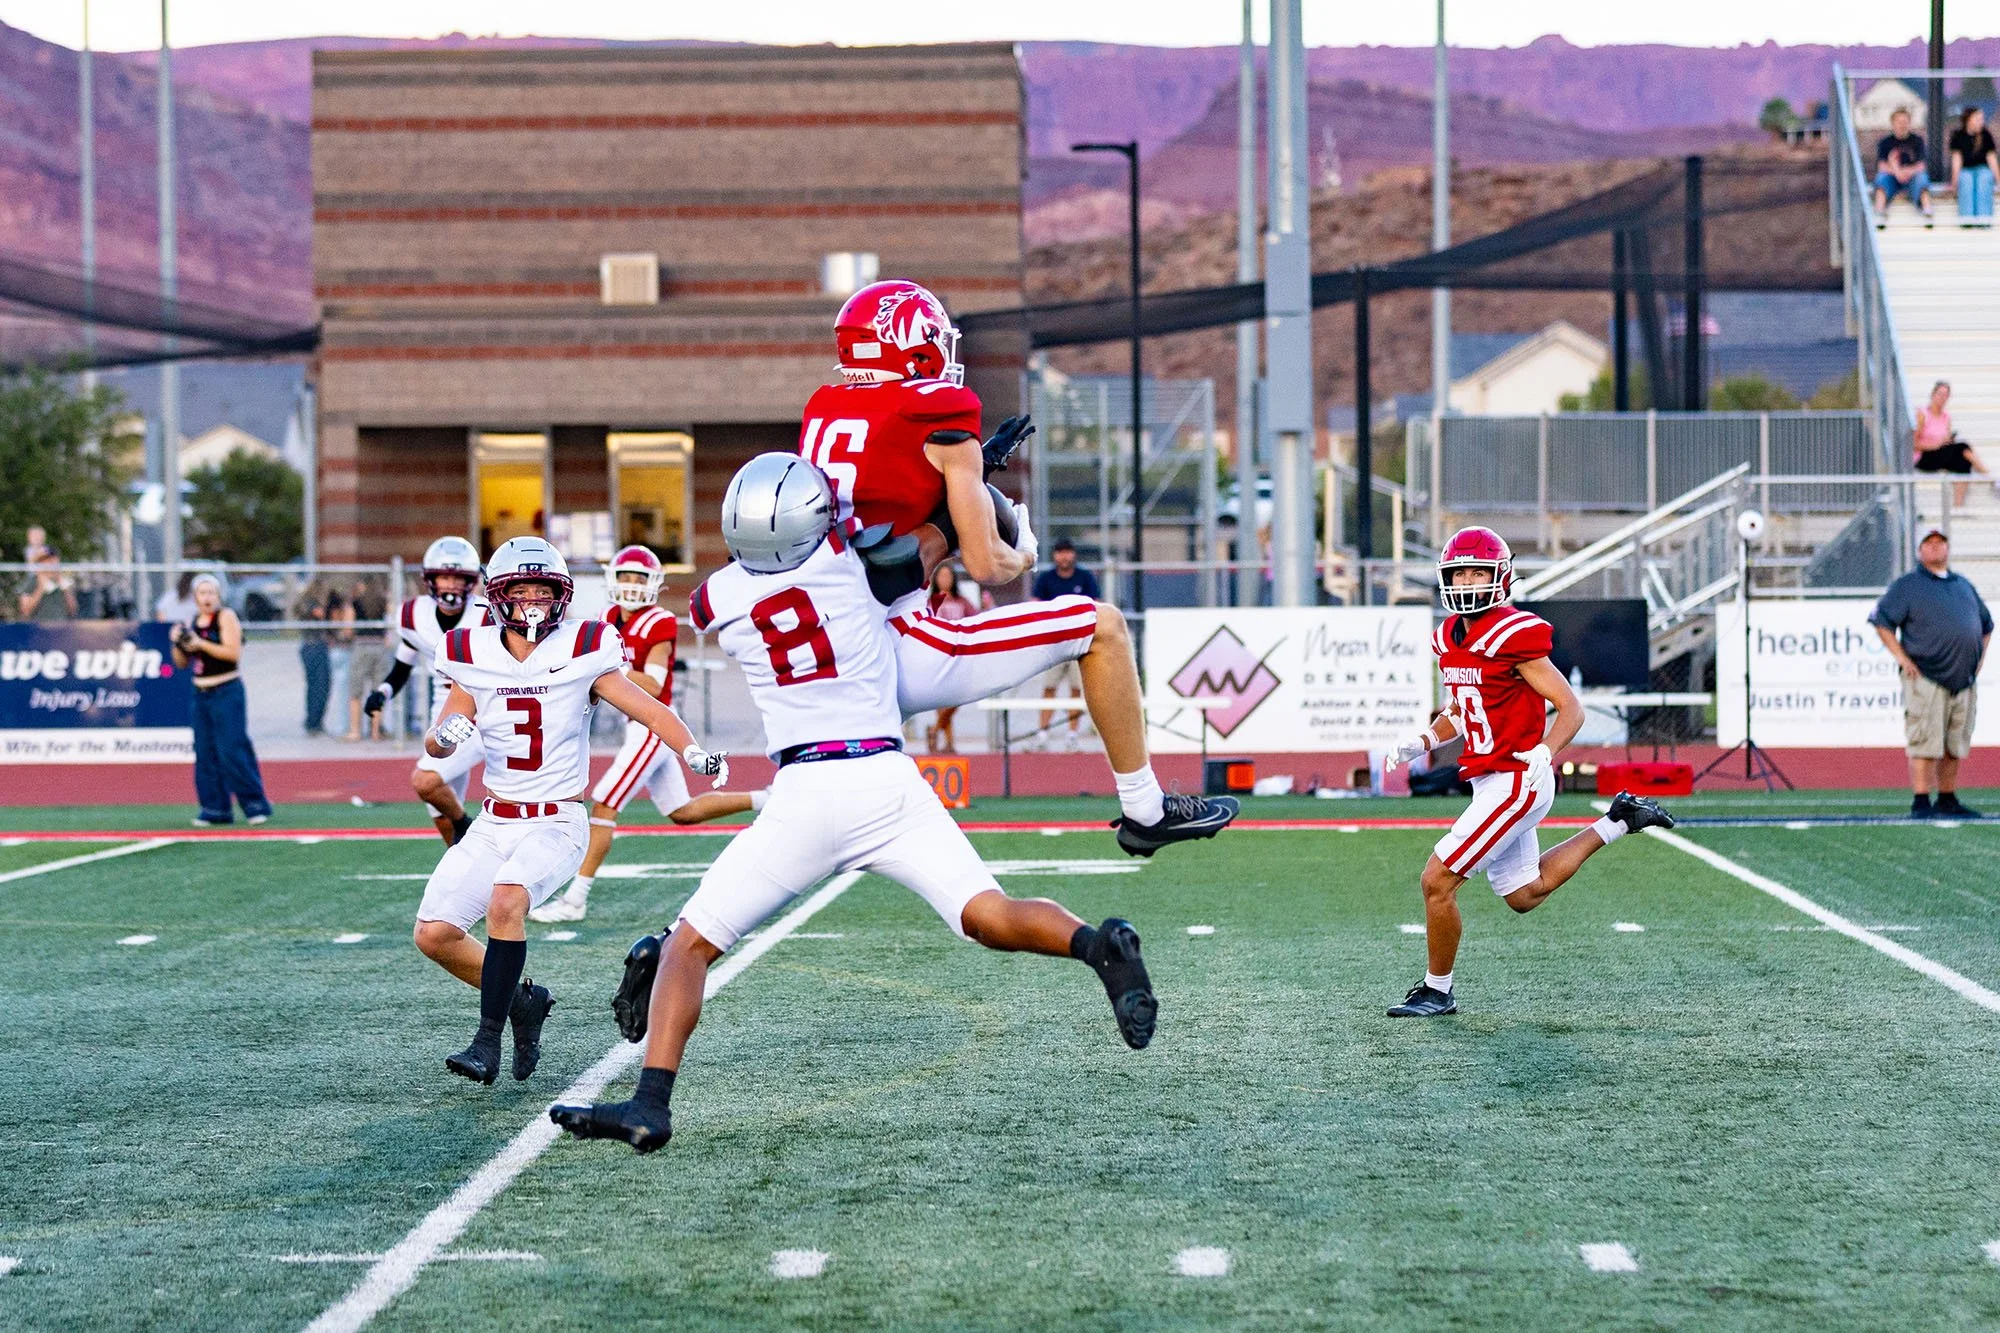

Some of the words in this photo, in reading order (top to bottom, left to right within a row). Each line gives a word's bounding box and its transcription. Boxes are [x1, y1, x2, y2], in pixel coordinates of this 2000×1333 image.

[802, 418, 869, 518] 16
[750, 587, 838, 687] 8
[0, 650, 69, 680] we
[1303, 671, 1415, 684] DENTAL
[496, 687, 520, 696] CEDAR
[521, 685, 549, 695] VALLEY
[1749, 692, 1815, 709] Justin
[506, 697, 544, 772] 3
